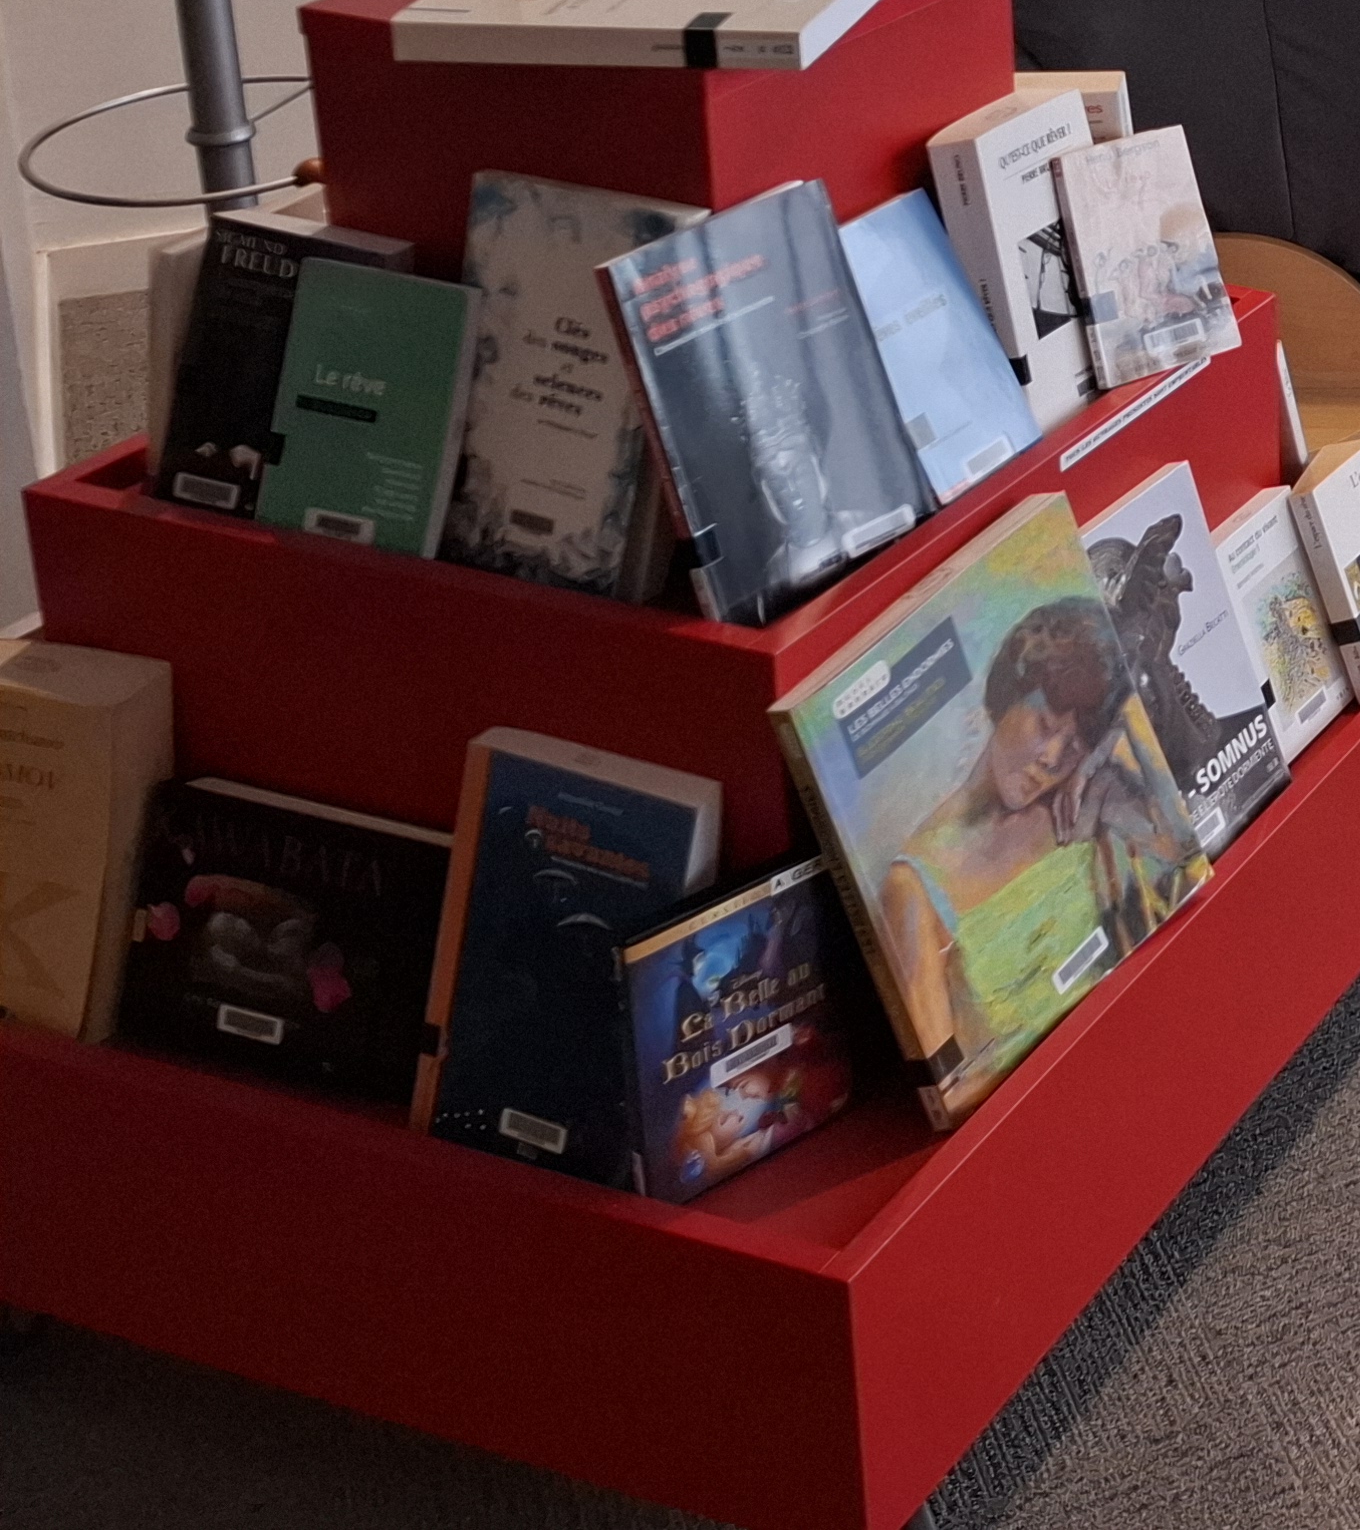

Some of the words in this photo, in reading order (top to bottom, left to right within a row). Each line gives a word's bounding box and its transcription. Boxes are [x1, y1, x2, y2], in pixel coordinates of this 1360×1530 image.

[1031, 136, 1047, 155] QUE
[1115, 140, 1160, 159] Bergson
[221, 245, 299, 279] FREUD
[316, 363, 338, 386] Le
[342, 371, 388, 397] rêve
[847, 713, 869, 736] LES
[867, 684, 902, 720] BELLES
[1196, 714, 1268, 794] SOMNUS
[1231, 737, 1276, 788] DORMIENTE
[681, 1012, 715, 1043] La
[720, 977, 780, 1021] Belle
[787, 963, 810, 986] au
[662, 1038, 723, 1085] Bois
[727, 983, 826, 1050] Dormant
